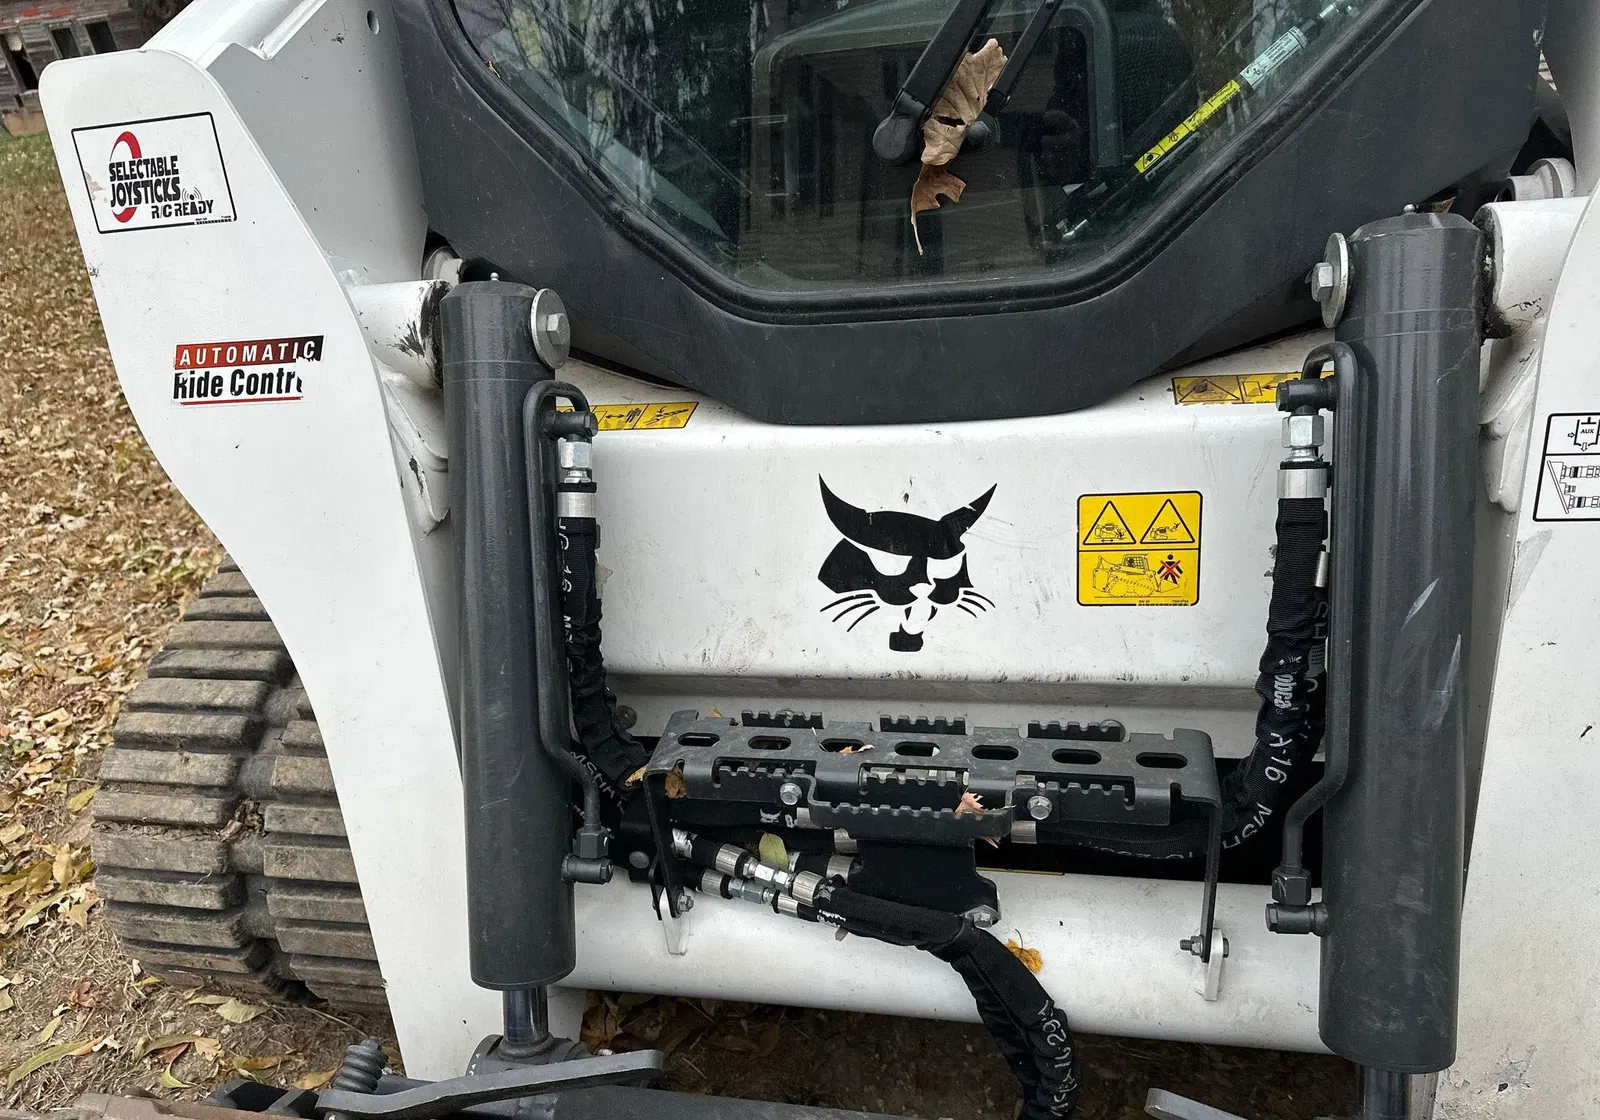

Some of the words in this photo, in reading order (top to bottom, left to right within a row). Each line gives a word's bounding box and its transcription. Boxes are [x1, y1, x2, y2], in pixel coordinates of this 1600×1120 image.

[108, 155, 179, 182] SELECTABLE
[110, 176, 181, 207] JOYSTICKS
[174, 199, 214, 217] READY
[179, 340, 316, 366] AUTOMATIC
[173, 370, 224, 399] Ride
[1273, 671, 1299, 711] obca
